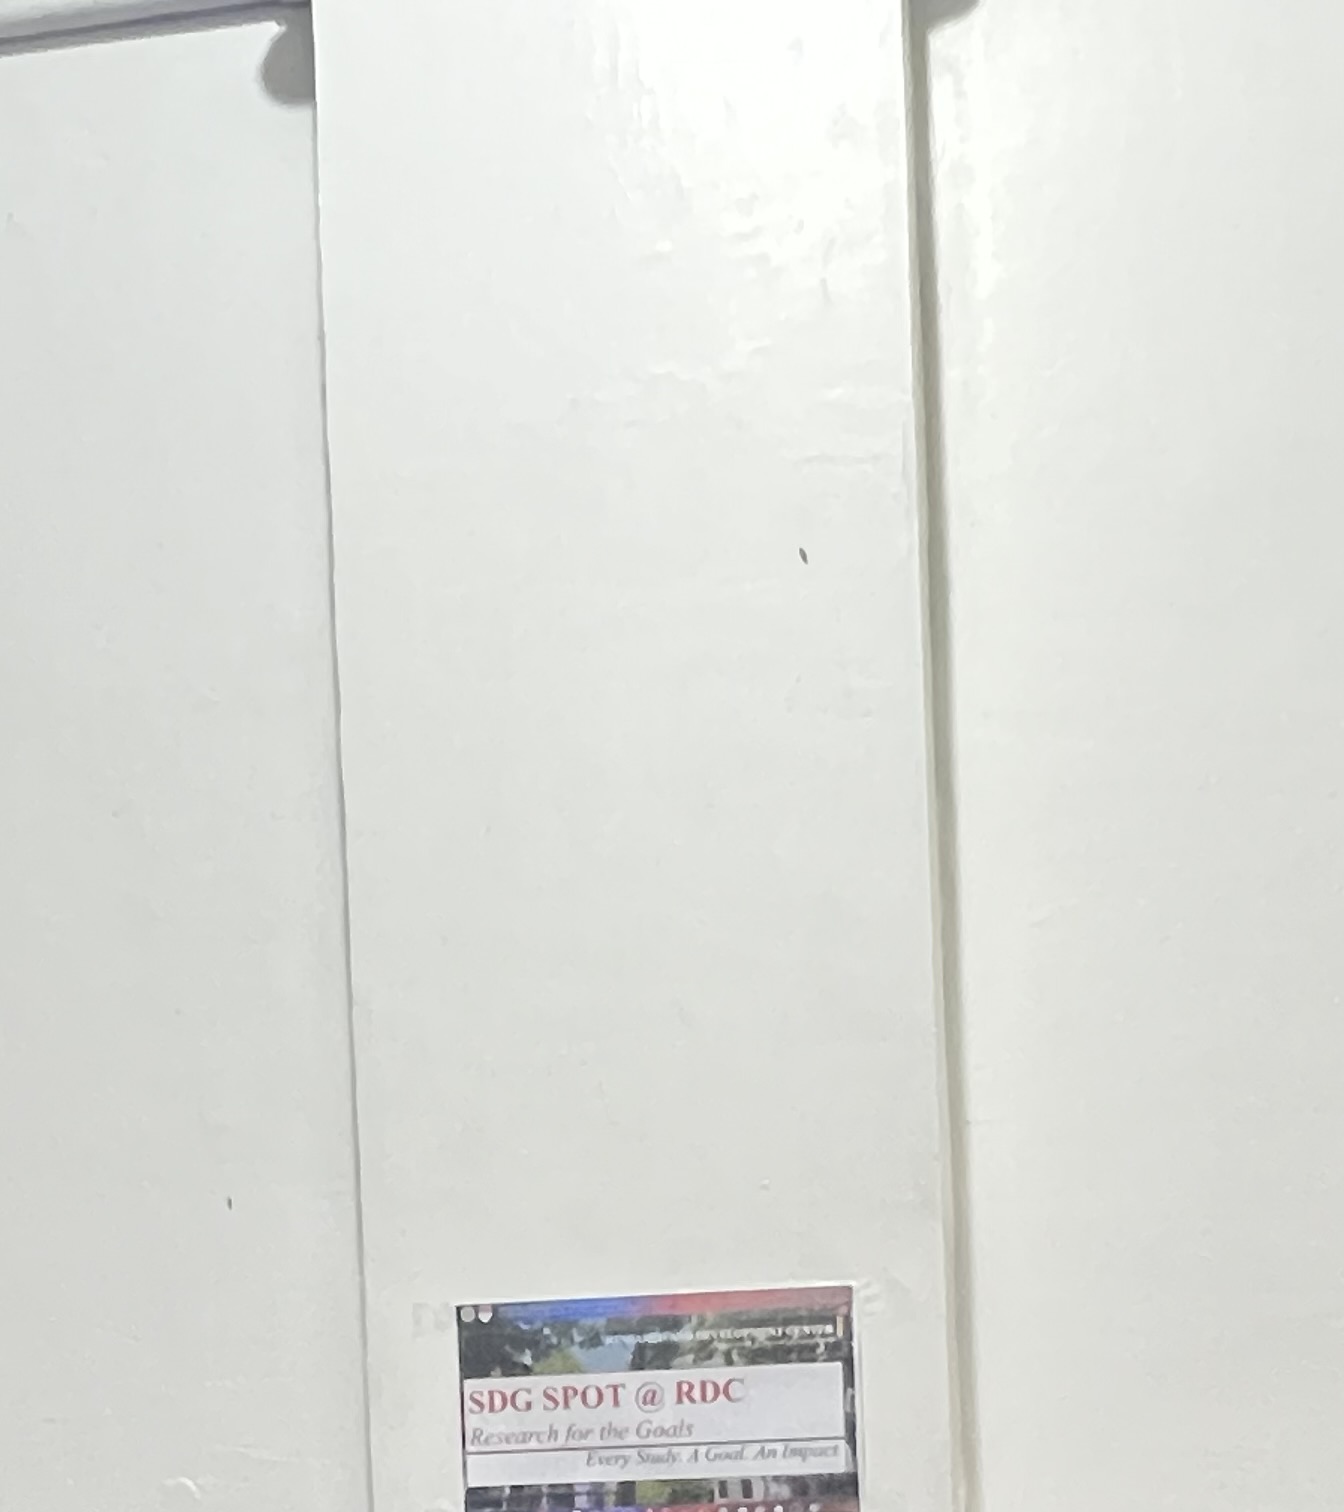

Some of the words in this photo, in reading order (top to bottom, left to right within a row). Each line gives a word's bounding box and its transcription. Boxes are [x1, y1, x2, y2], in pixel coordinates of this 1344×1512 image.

[468, 1388, 532, 1414] SDG
[542, 1383, 626, 1411] SPOT
[635, 1381, 665, 1413] @
[675, 1378, 745, 1405] RDC
[470, 1423, 558, 1447] Research
[564, 1422, 595, 1445] for
[599, 1421, 629, 1442] the
[636, 1418, 694, 1440] Goals
[586, 1450, 631, 1470] Every
[754, 1446, 777, 1460] An
